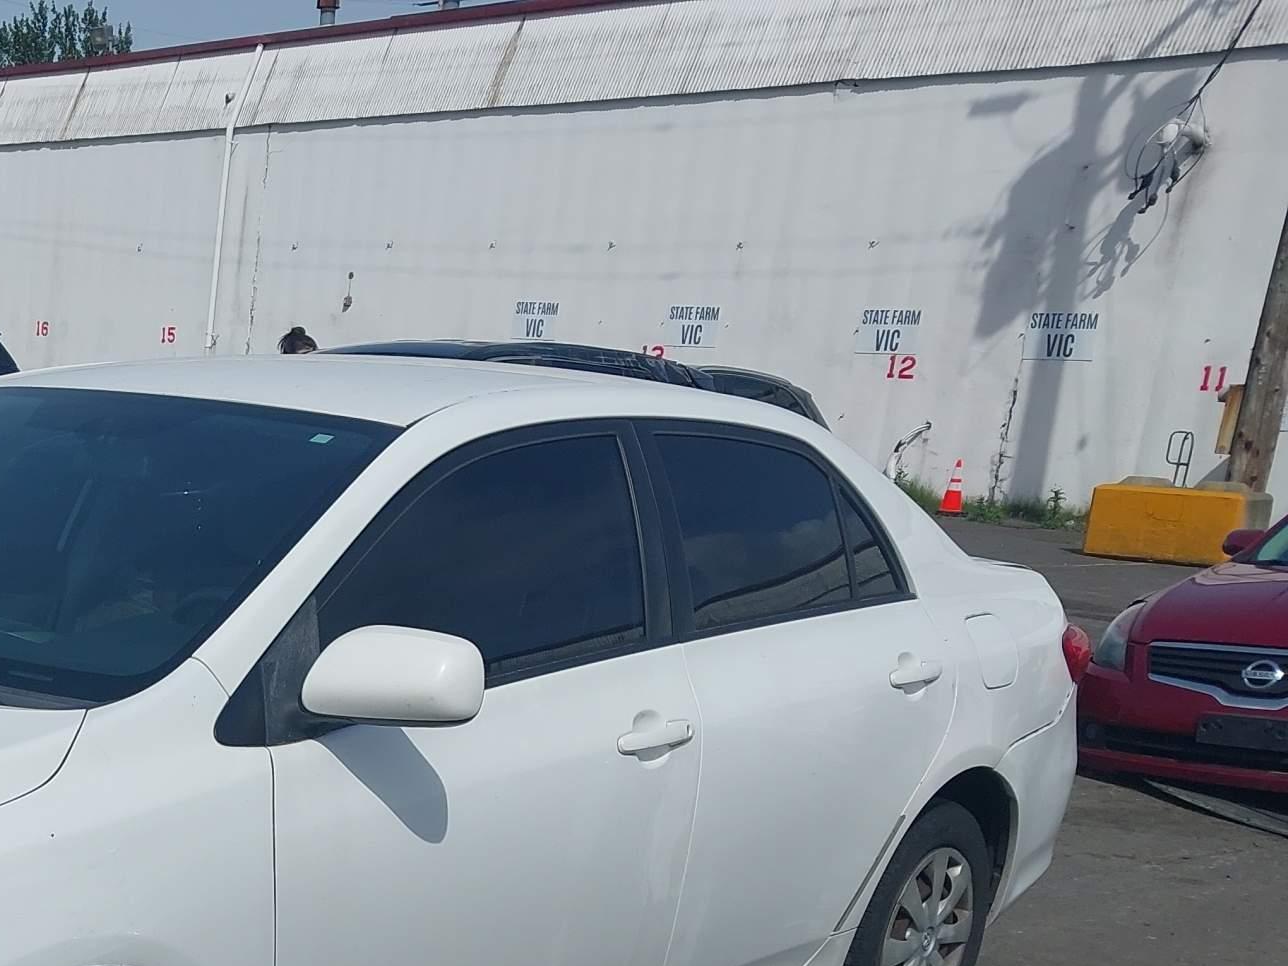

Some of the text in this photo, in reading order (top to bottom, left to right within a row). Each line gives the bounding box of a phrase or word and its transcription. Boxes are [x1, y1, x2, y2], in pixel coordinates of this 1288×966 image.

[515, 302, 560, 316] STATE FARM
[669, 306, 721, 321] STATE FARM
[862, 309, 922, 326] STATE FARM
[36, 320, 49, 337] 16
[525, 318, 544, 338] VIC
[1030, 312, 1099, 330] STATE FARM
[161, 326, 176, 344] 15
[681, 324, 703, 345] VIC
[875, 329, 901, 352] VIC
[1046, 333, 1075, 358] VIC
[886, 354, 917, 380] 12
[1200, 365, 1227, 391] 11
